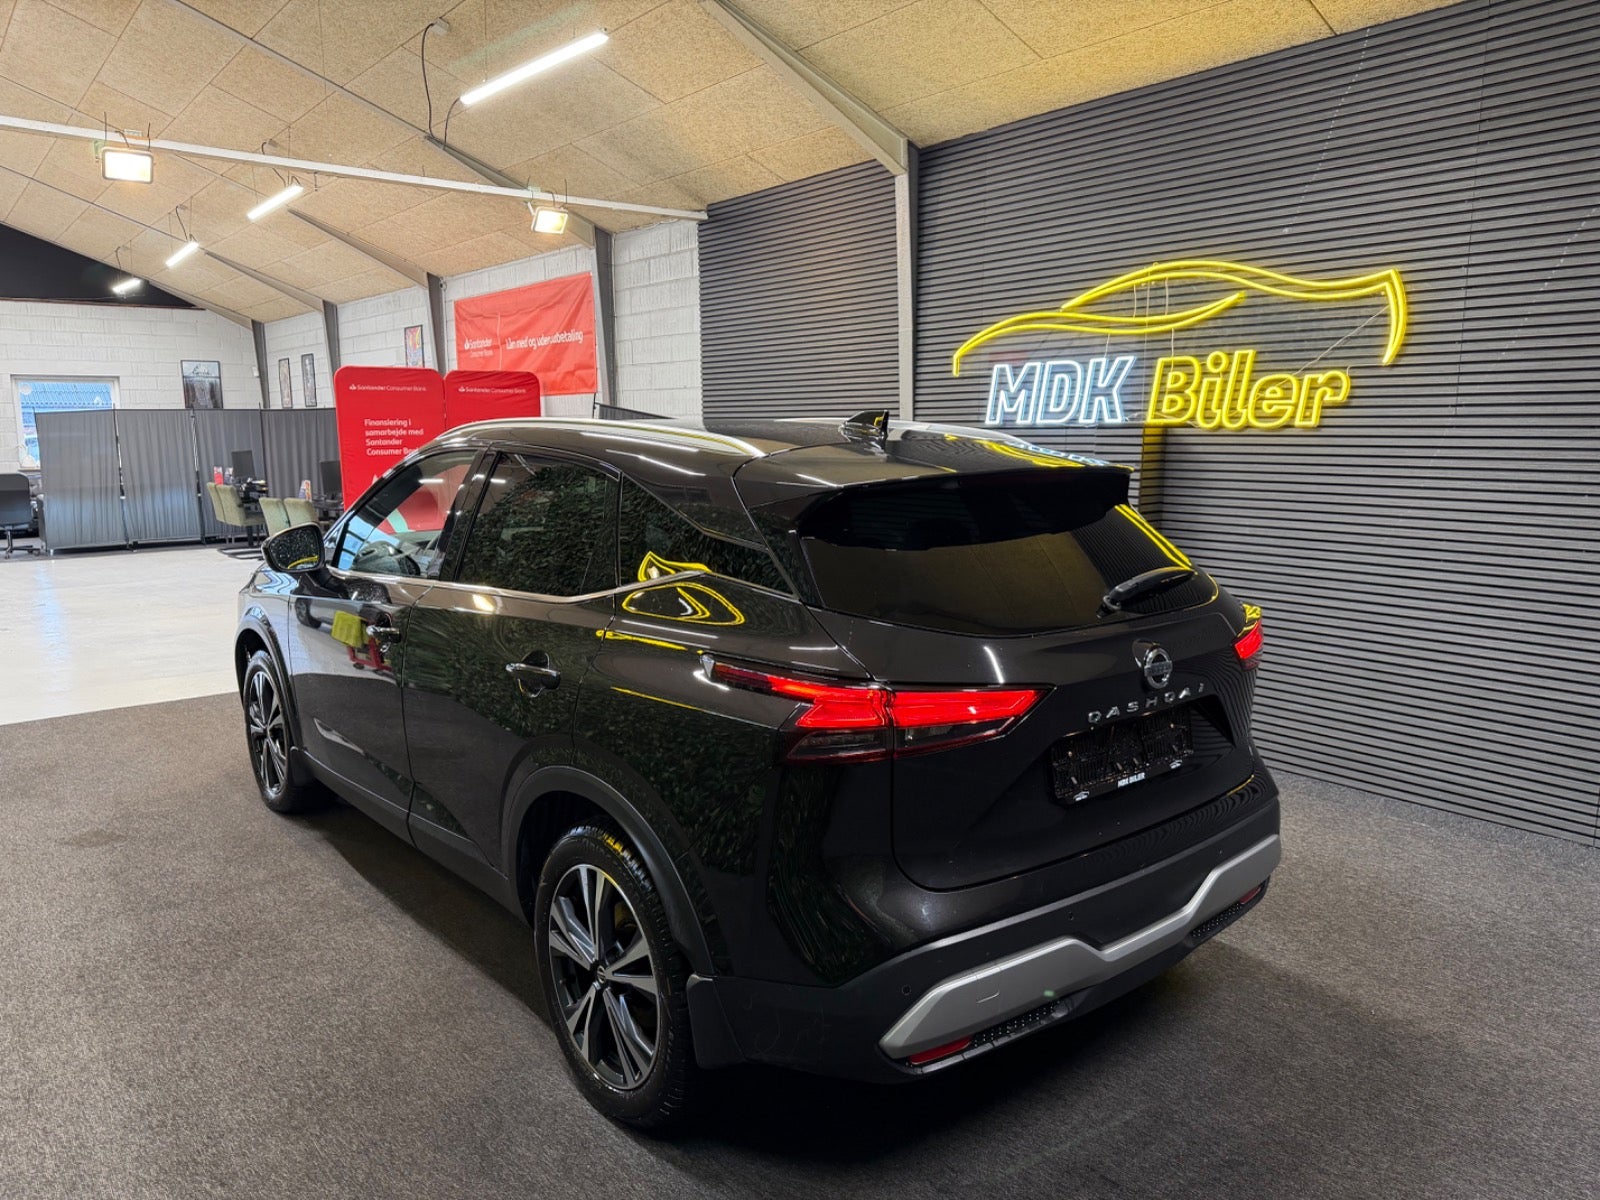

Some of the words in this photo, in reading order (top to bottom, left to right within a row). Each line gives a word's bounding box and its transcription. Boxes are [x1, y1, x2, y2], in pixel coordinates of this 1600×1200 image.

[469, 337, 492, 349] Santander
[517, 335, 529, 348] med
[529, 338, 537, 350] og
[386, 384, 412, 392] Consumer
[985, 355, 1136, 425] MDK
[1145, 349, 1351, 430] Biler
[364, 418, 408, 428] Finansiering
[365, 428, 407, 437] samarbejde
[408, 428, 424, 436] med
[365, 438, 402, 446] Santander
[366, 447, 402, 456] Consumer
[1088, 683, 1205, 724] QASHQAI
